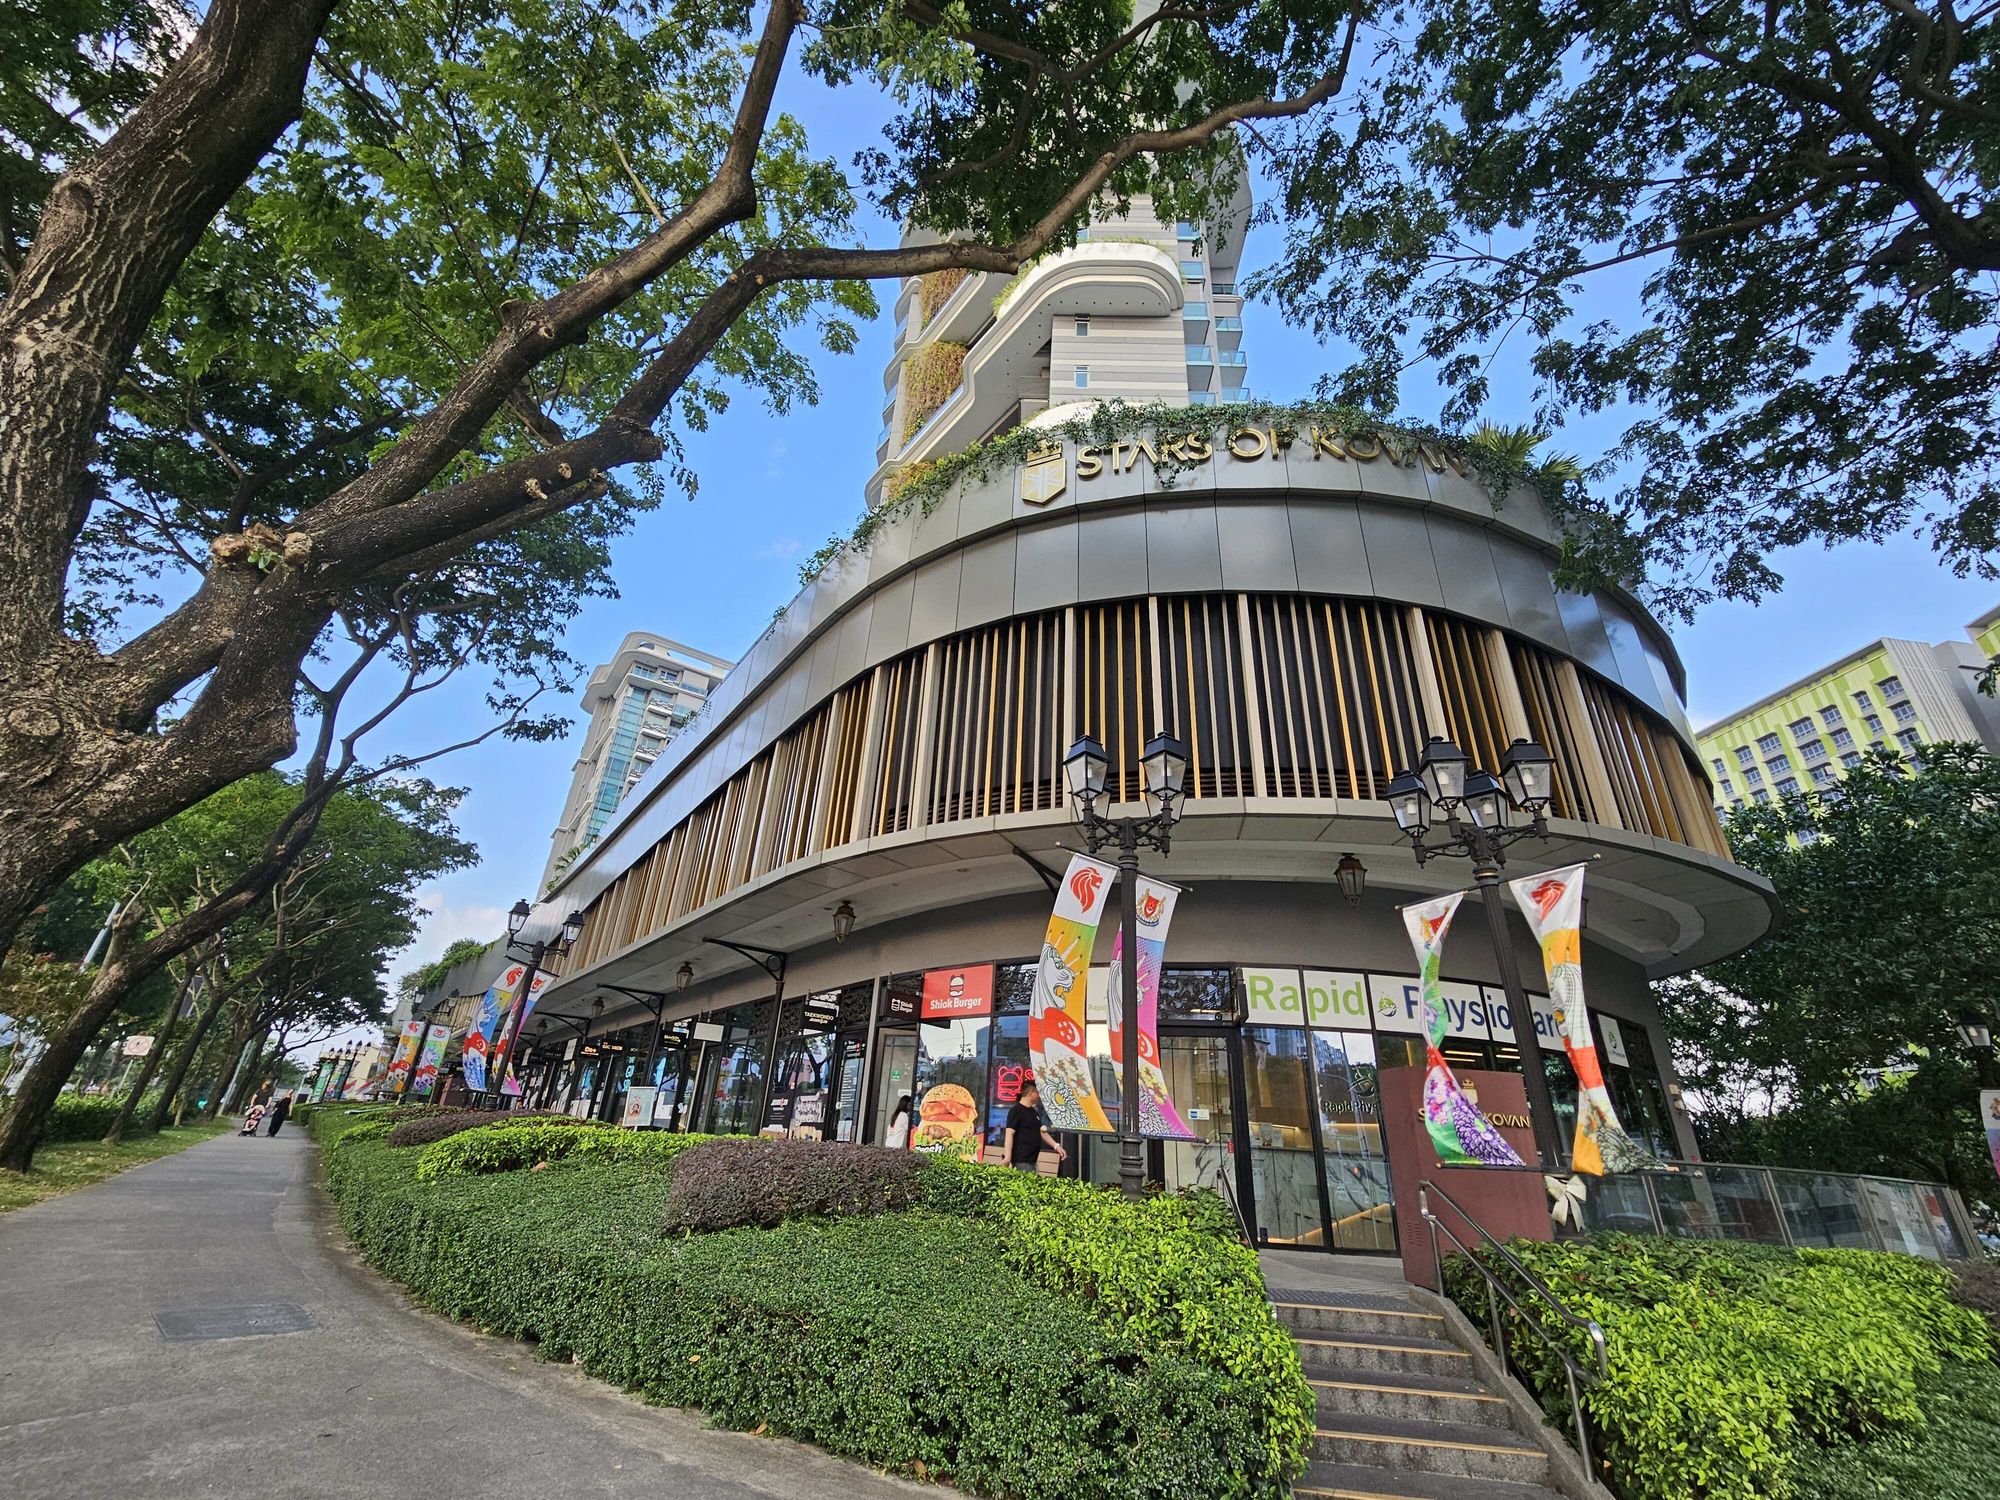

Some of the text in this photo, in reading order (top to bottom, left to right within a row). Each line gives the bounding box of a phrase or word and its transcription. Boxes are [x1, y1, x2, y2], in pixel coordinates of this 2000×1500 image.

[1076, 432, 1213, 478] STARS
[1248, 974, 1366, 1021] Rapid
[900, 1000, 914, 1008] Shiok
[930, 998, 982, 1010] Shiok Burger
[804, 1011, 834, 1021] TAEKWONDO
